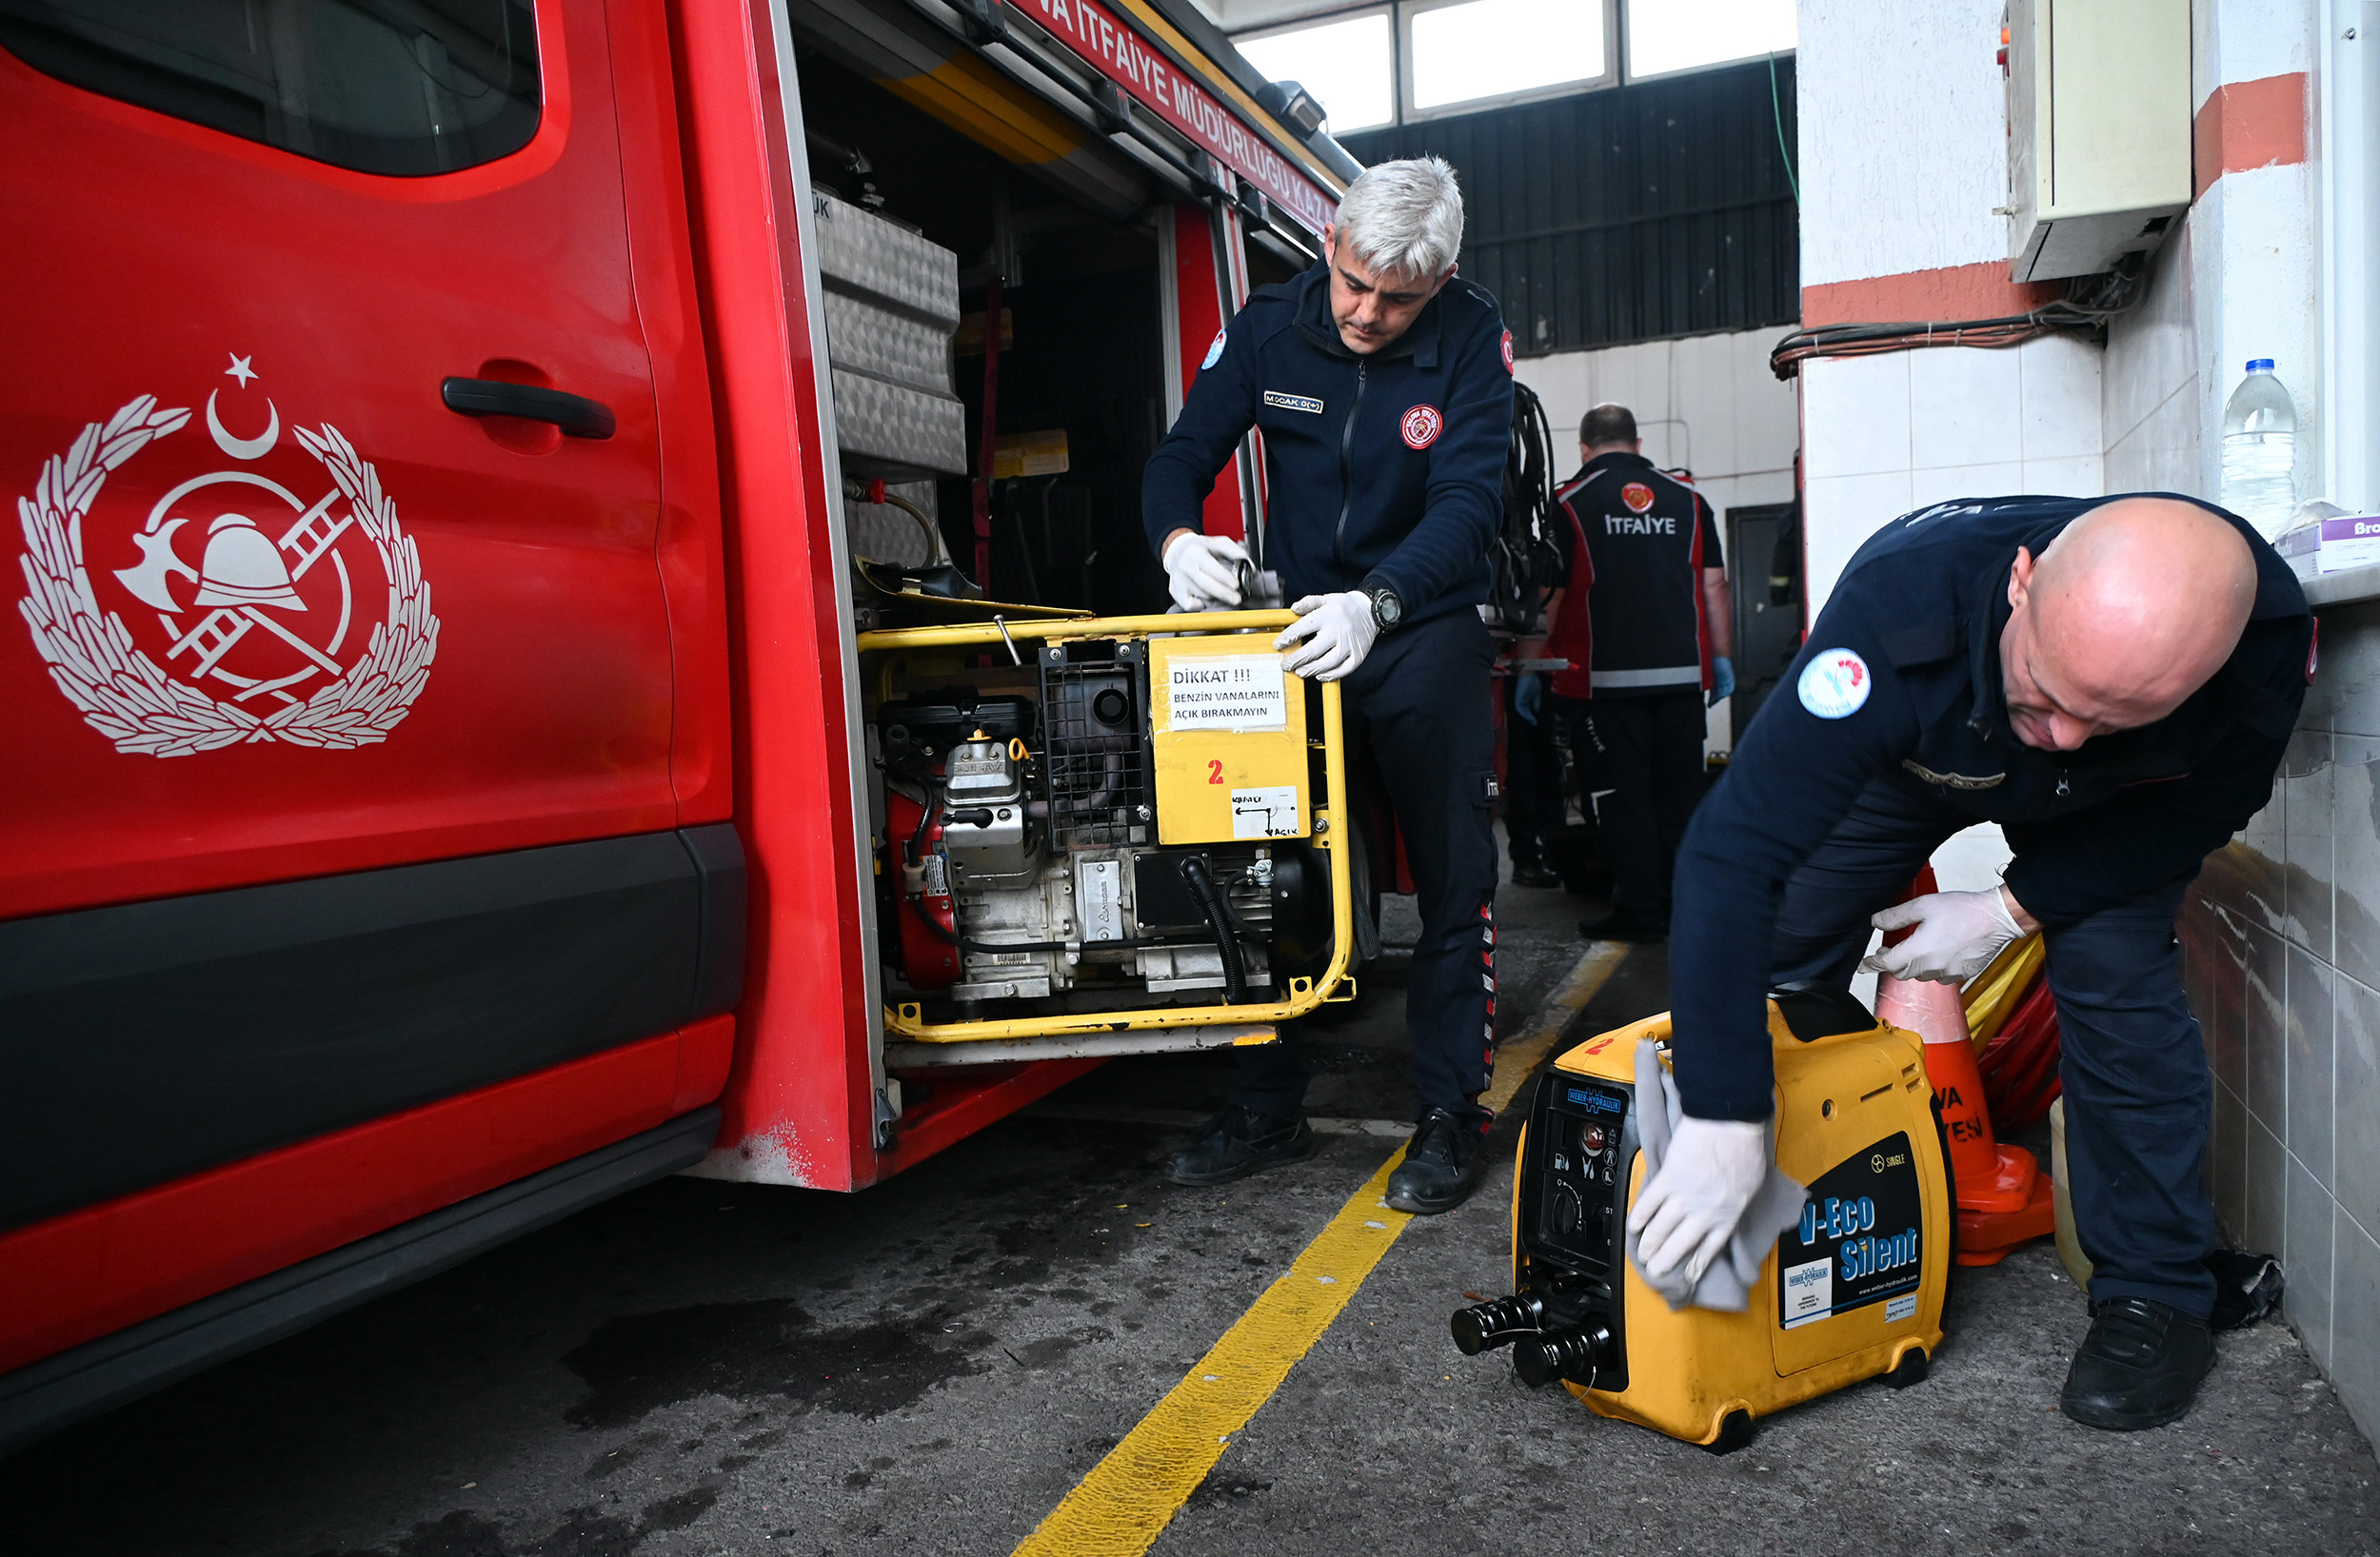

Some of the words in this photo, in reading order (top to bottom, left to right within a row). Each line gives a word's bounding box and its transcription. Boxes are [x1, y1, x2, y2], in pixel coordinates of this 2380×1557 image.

[1173, 77, 1290, 199] MÜDÜRLÜĞÜ
[1174, 668, 1229, 684] DİKKAT
[1235, 668, 1250, 682] !!!
[1174, 691, 1213, 703] BENZİN
[1215, 690, 1279, 701] VANALARINI
[1175, 709, 1199, 720] AÇIK
[1201, 707, 1268, 719] BIRAKMAYIN
[1208, 759, 1224, 785] 2
[1569, 1091, 1619, 1112] WEBER-HYDRAULIK
[1886, 1153, 1906, 1168] SINGLE
[1840, 1227, 1917, 1282] Silent
[1858, 1274, 1918, 1295] www.weber-hydraulik.com
